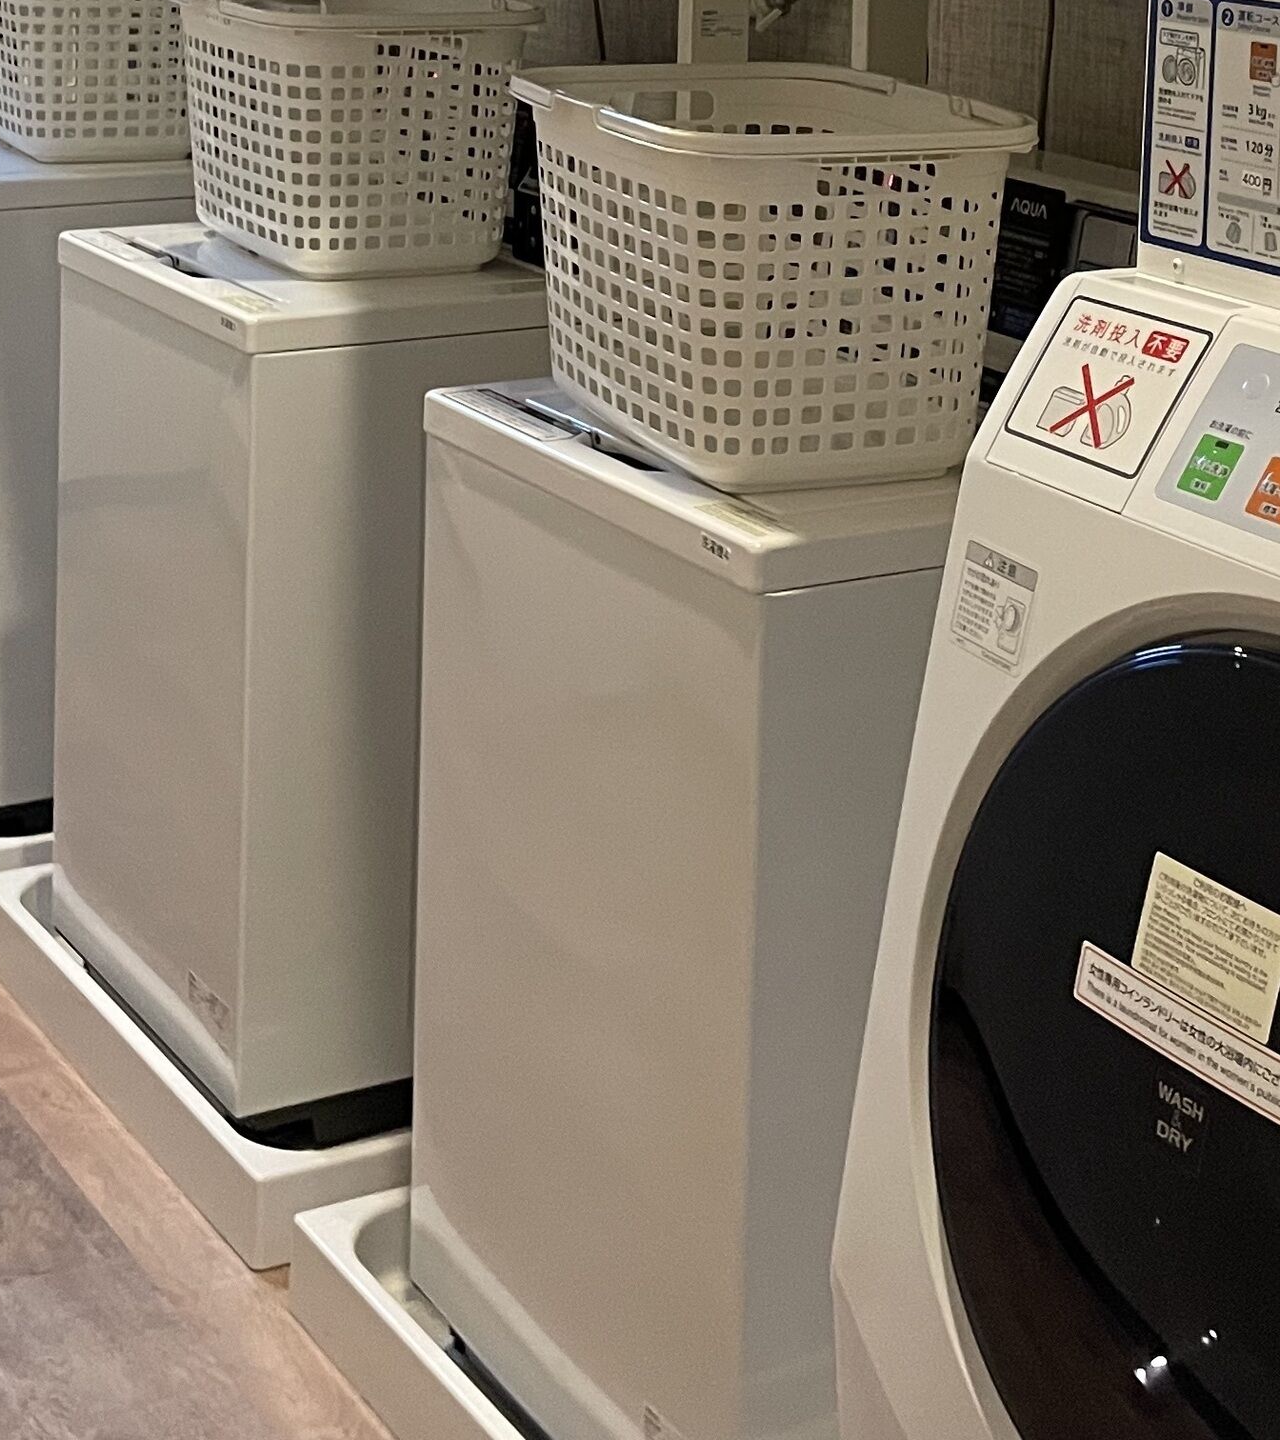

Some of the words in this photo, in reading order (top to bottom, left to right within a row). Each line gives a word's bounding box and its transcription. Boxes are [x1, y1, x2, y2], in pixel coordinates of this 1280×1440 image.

[1245, 140, 1274, 158] 120分
[1242, 173, 1273, 192] 400円
[1010, 197, 1047, 220] AQUA
[1073, 313, 1142, 348] 洗剤投入
[1147, 334, 1187, 361] 不要
[1062, 336, 1176, 377] 洗剤が自動で投入されます
[1158, 1080, 1204, 1123] WASH
[1156, 1119, 1193, 1153] DRY
